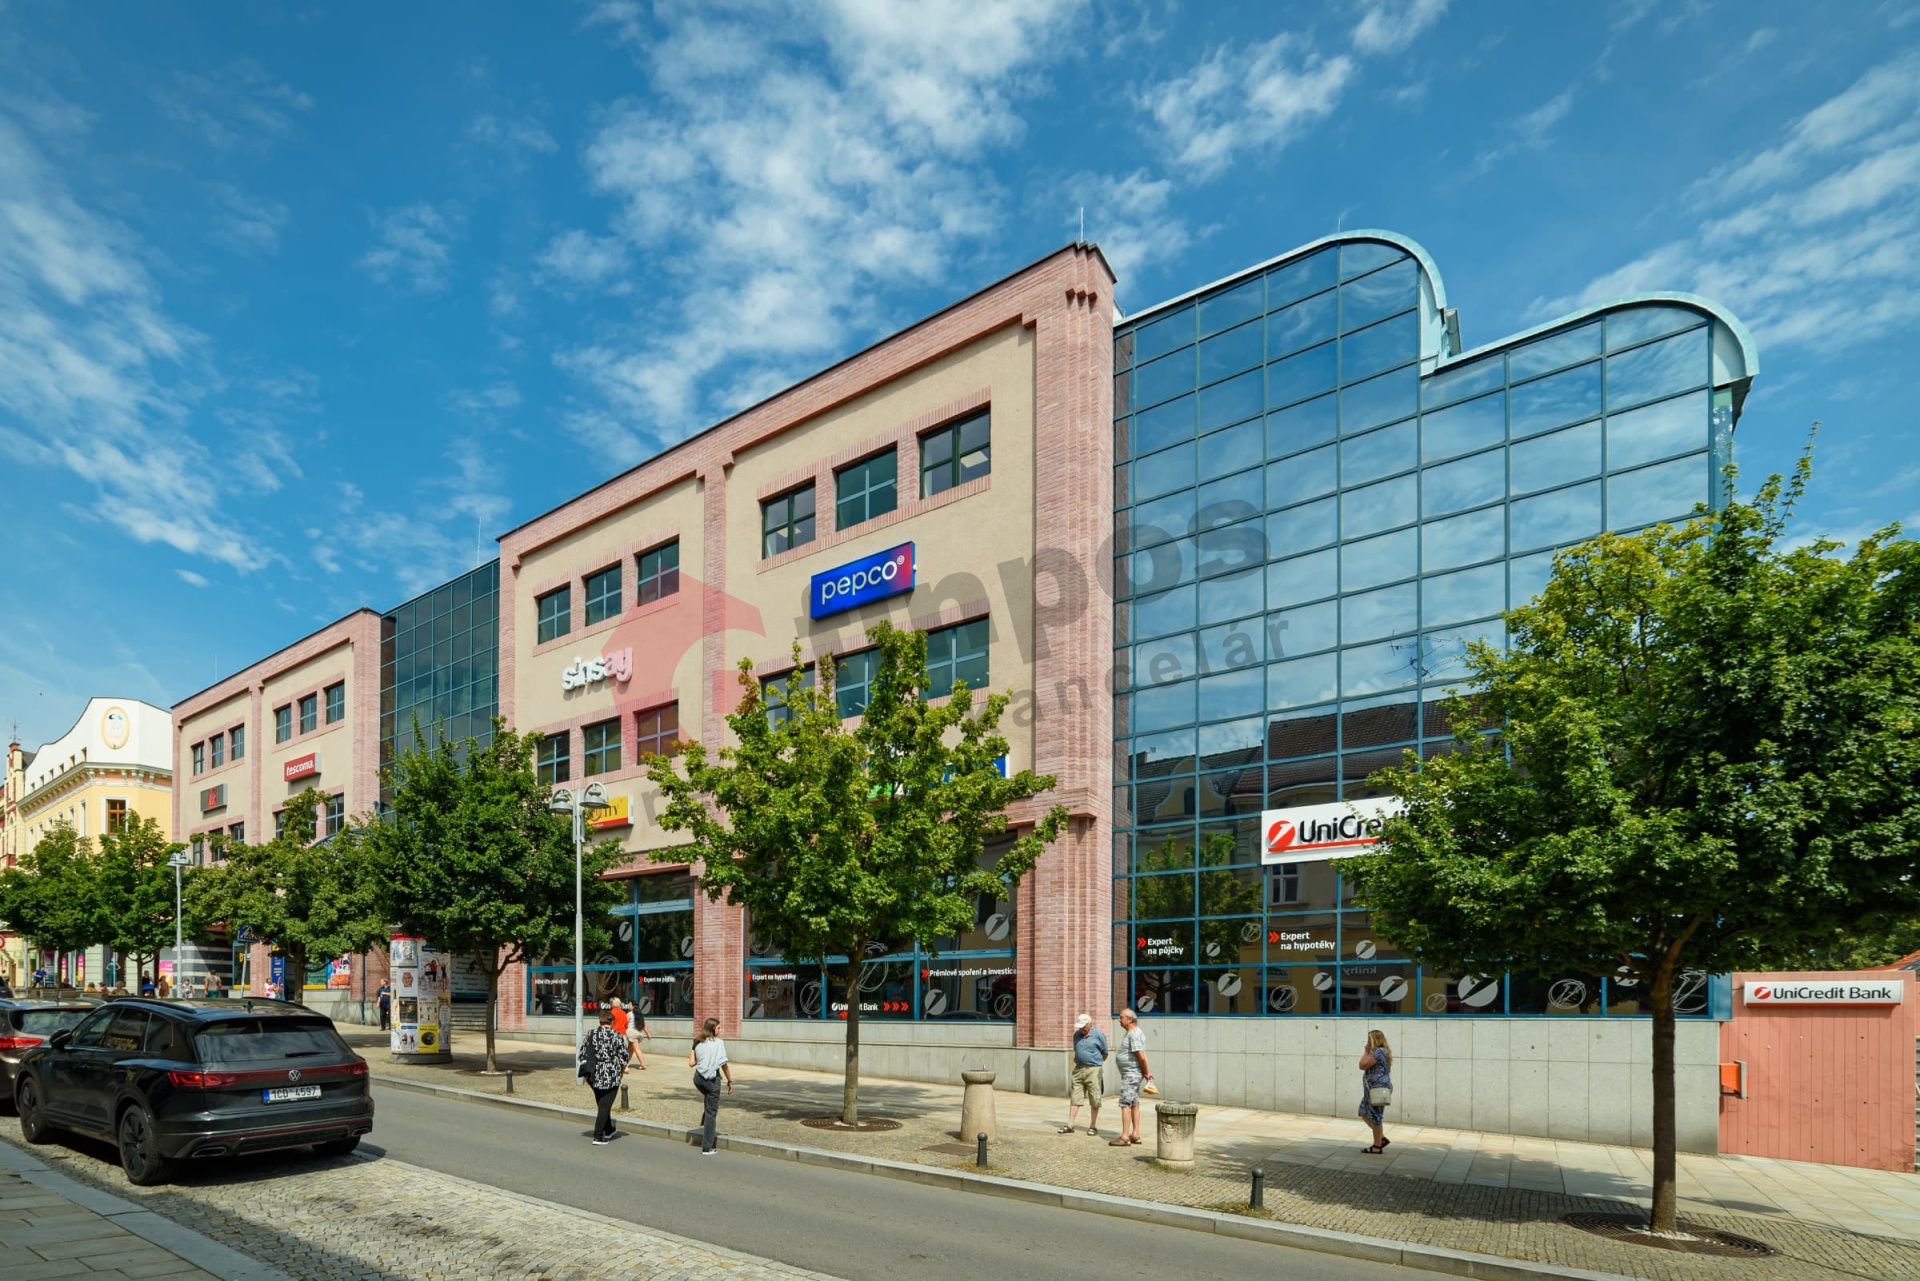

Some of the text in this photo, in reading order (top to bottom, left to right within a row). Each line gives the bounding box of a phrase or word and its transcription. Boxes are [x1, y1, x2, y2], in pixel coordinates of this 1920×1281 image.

[562, 647, 633, 691] sinsay
[1281, 932, 1310, 941] Expert
[1147, 938, 1172, 947] Expert
[1293, 941, 1335, 951] hypotéky
[1158, 946, 1184, 956] půjčky
[958, 968, 982, 977] spoření
[1773, 987, 1892, 1000] UniCredit Bank
[863, 1002, 878, 1011] Bank
[271, 1086, 317, 1099] 1CD 4597
